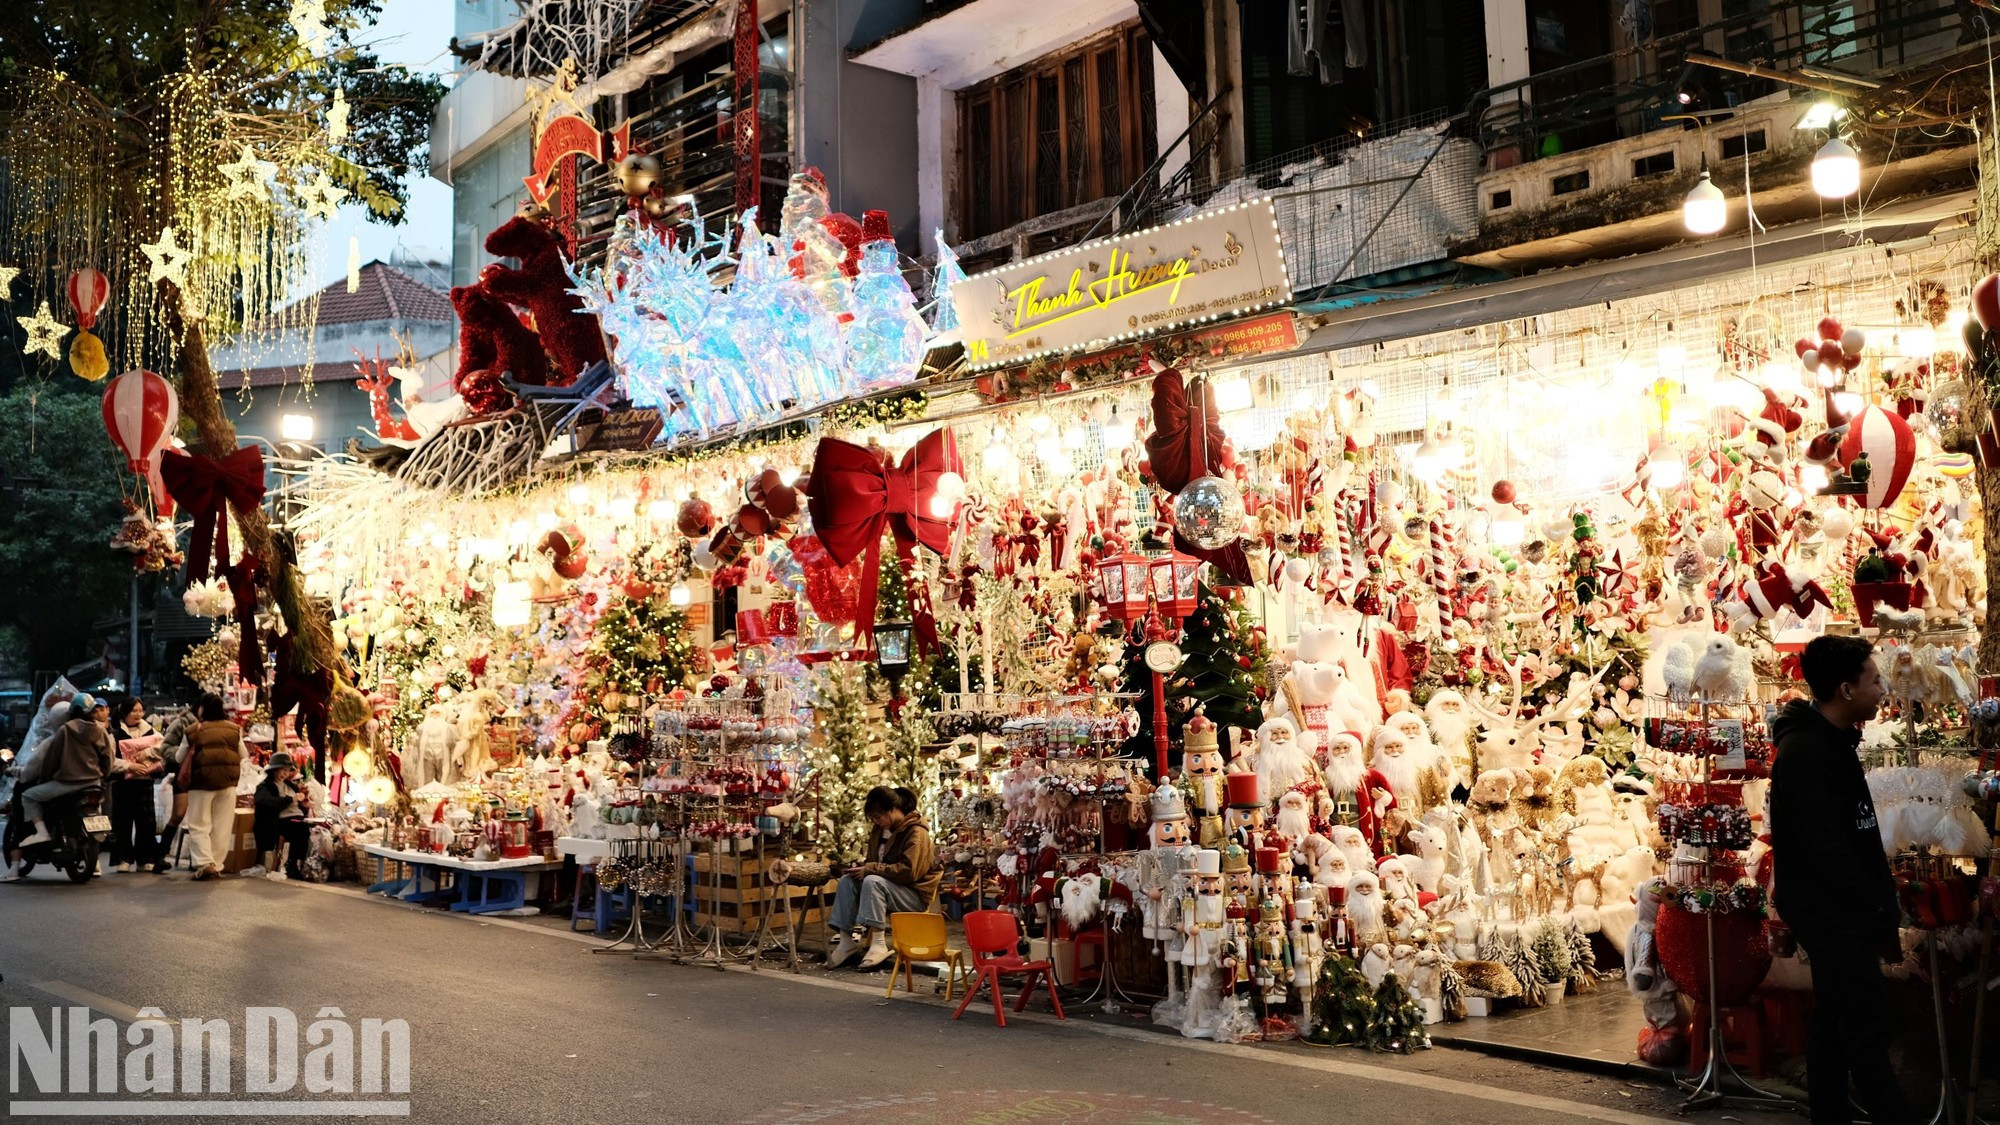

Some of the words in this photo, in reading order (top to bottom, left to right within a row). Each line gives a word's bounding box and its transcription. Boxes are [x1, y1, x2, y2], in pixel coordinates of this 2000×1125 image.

[545, 119, 575, 146] MERRY
[539, 134, 595, 175] CHRISTMAS
[1008, 268, 1084, 329] Thanh
[1200, 255, 1240, 273] Decor
[1223, 321, 1283, 342] 0966.909.205
